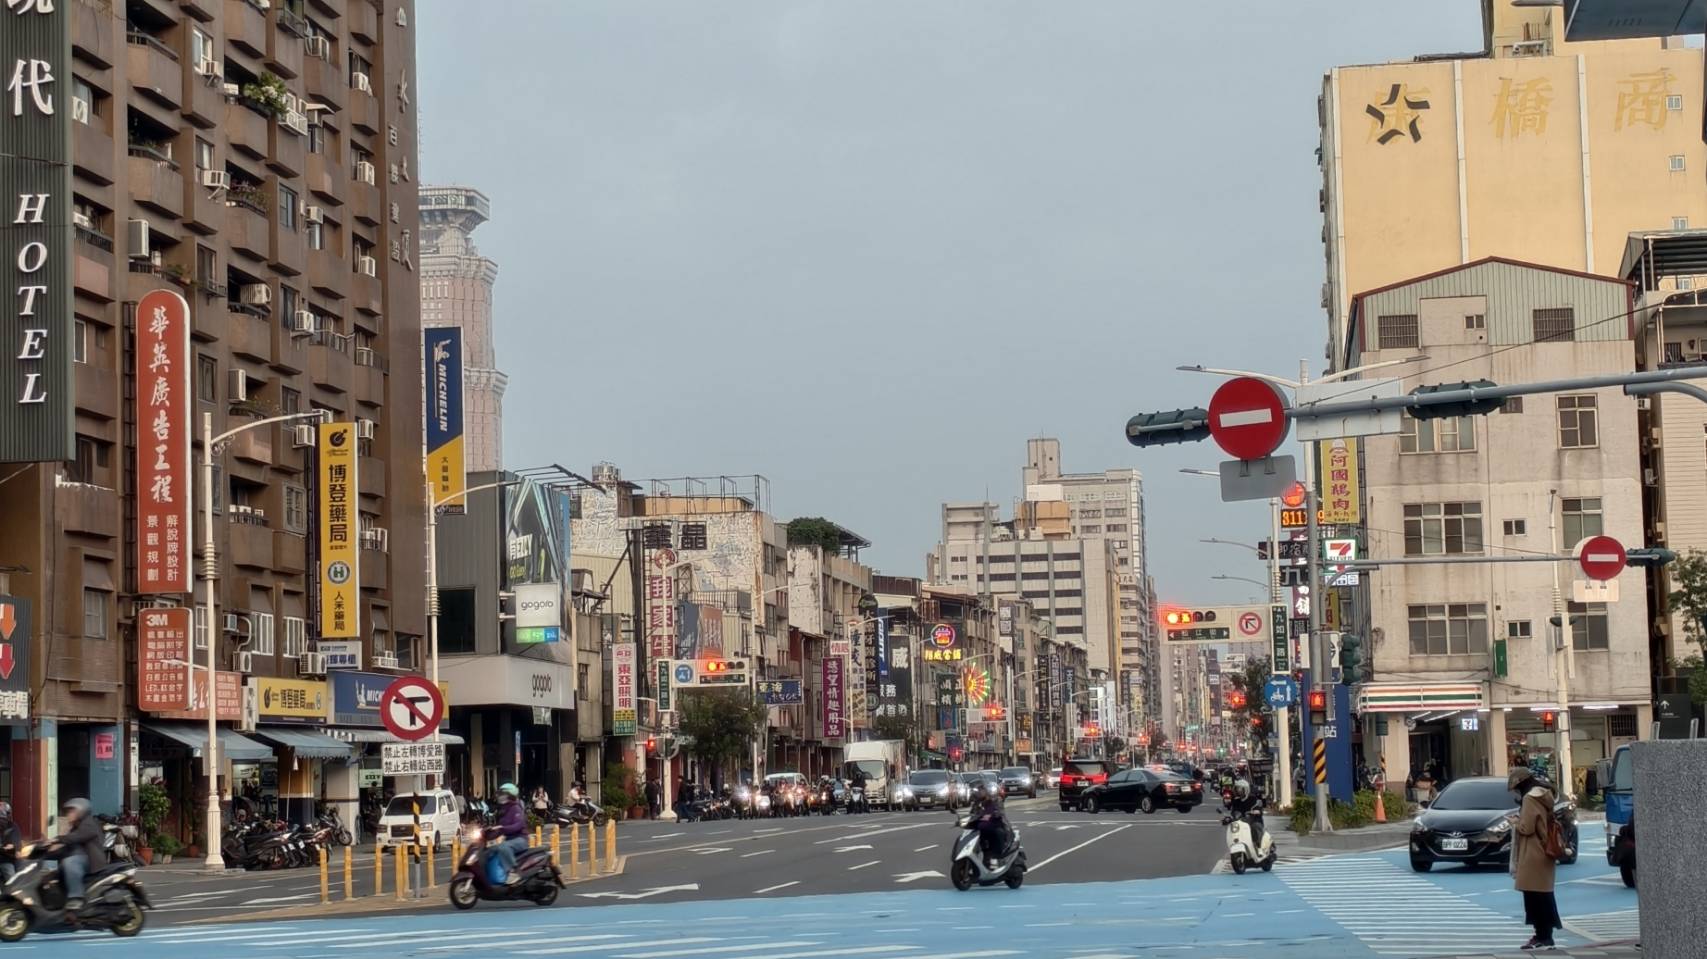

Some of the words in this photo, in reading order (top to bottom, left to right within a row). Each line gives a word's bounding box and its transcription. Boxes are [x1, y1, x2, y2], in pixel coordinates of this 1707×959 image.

[7, 0, 55, 116] 代
[13, 193, 50, 404] HOTEL
[148, 305, 173, 503] 華英廣告工程
[438, 363, 448, 432] MICHELIN
[328, 464, 348, 543] 博登藥局
[146, 515, 159, 582] 景觀規劃
[146, 614, 169, 627] 3M
[618, 663, 632, 708] 東亞照明
[384, 745, 443, 758] 禁止左轉博愛路
[384, 759, 443, 773] 禁止右轉站西路
